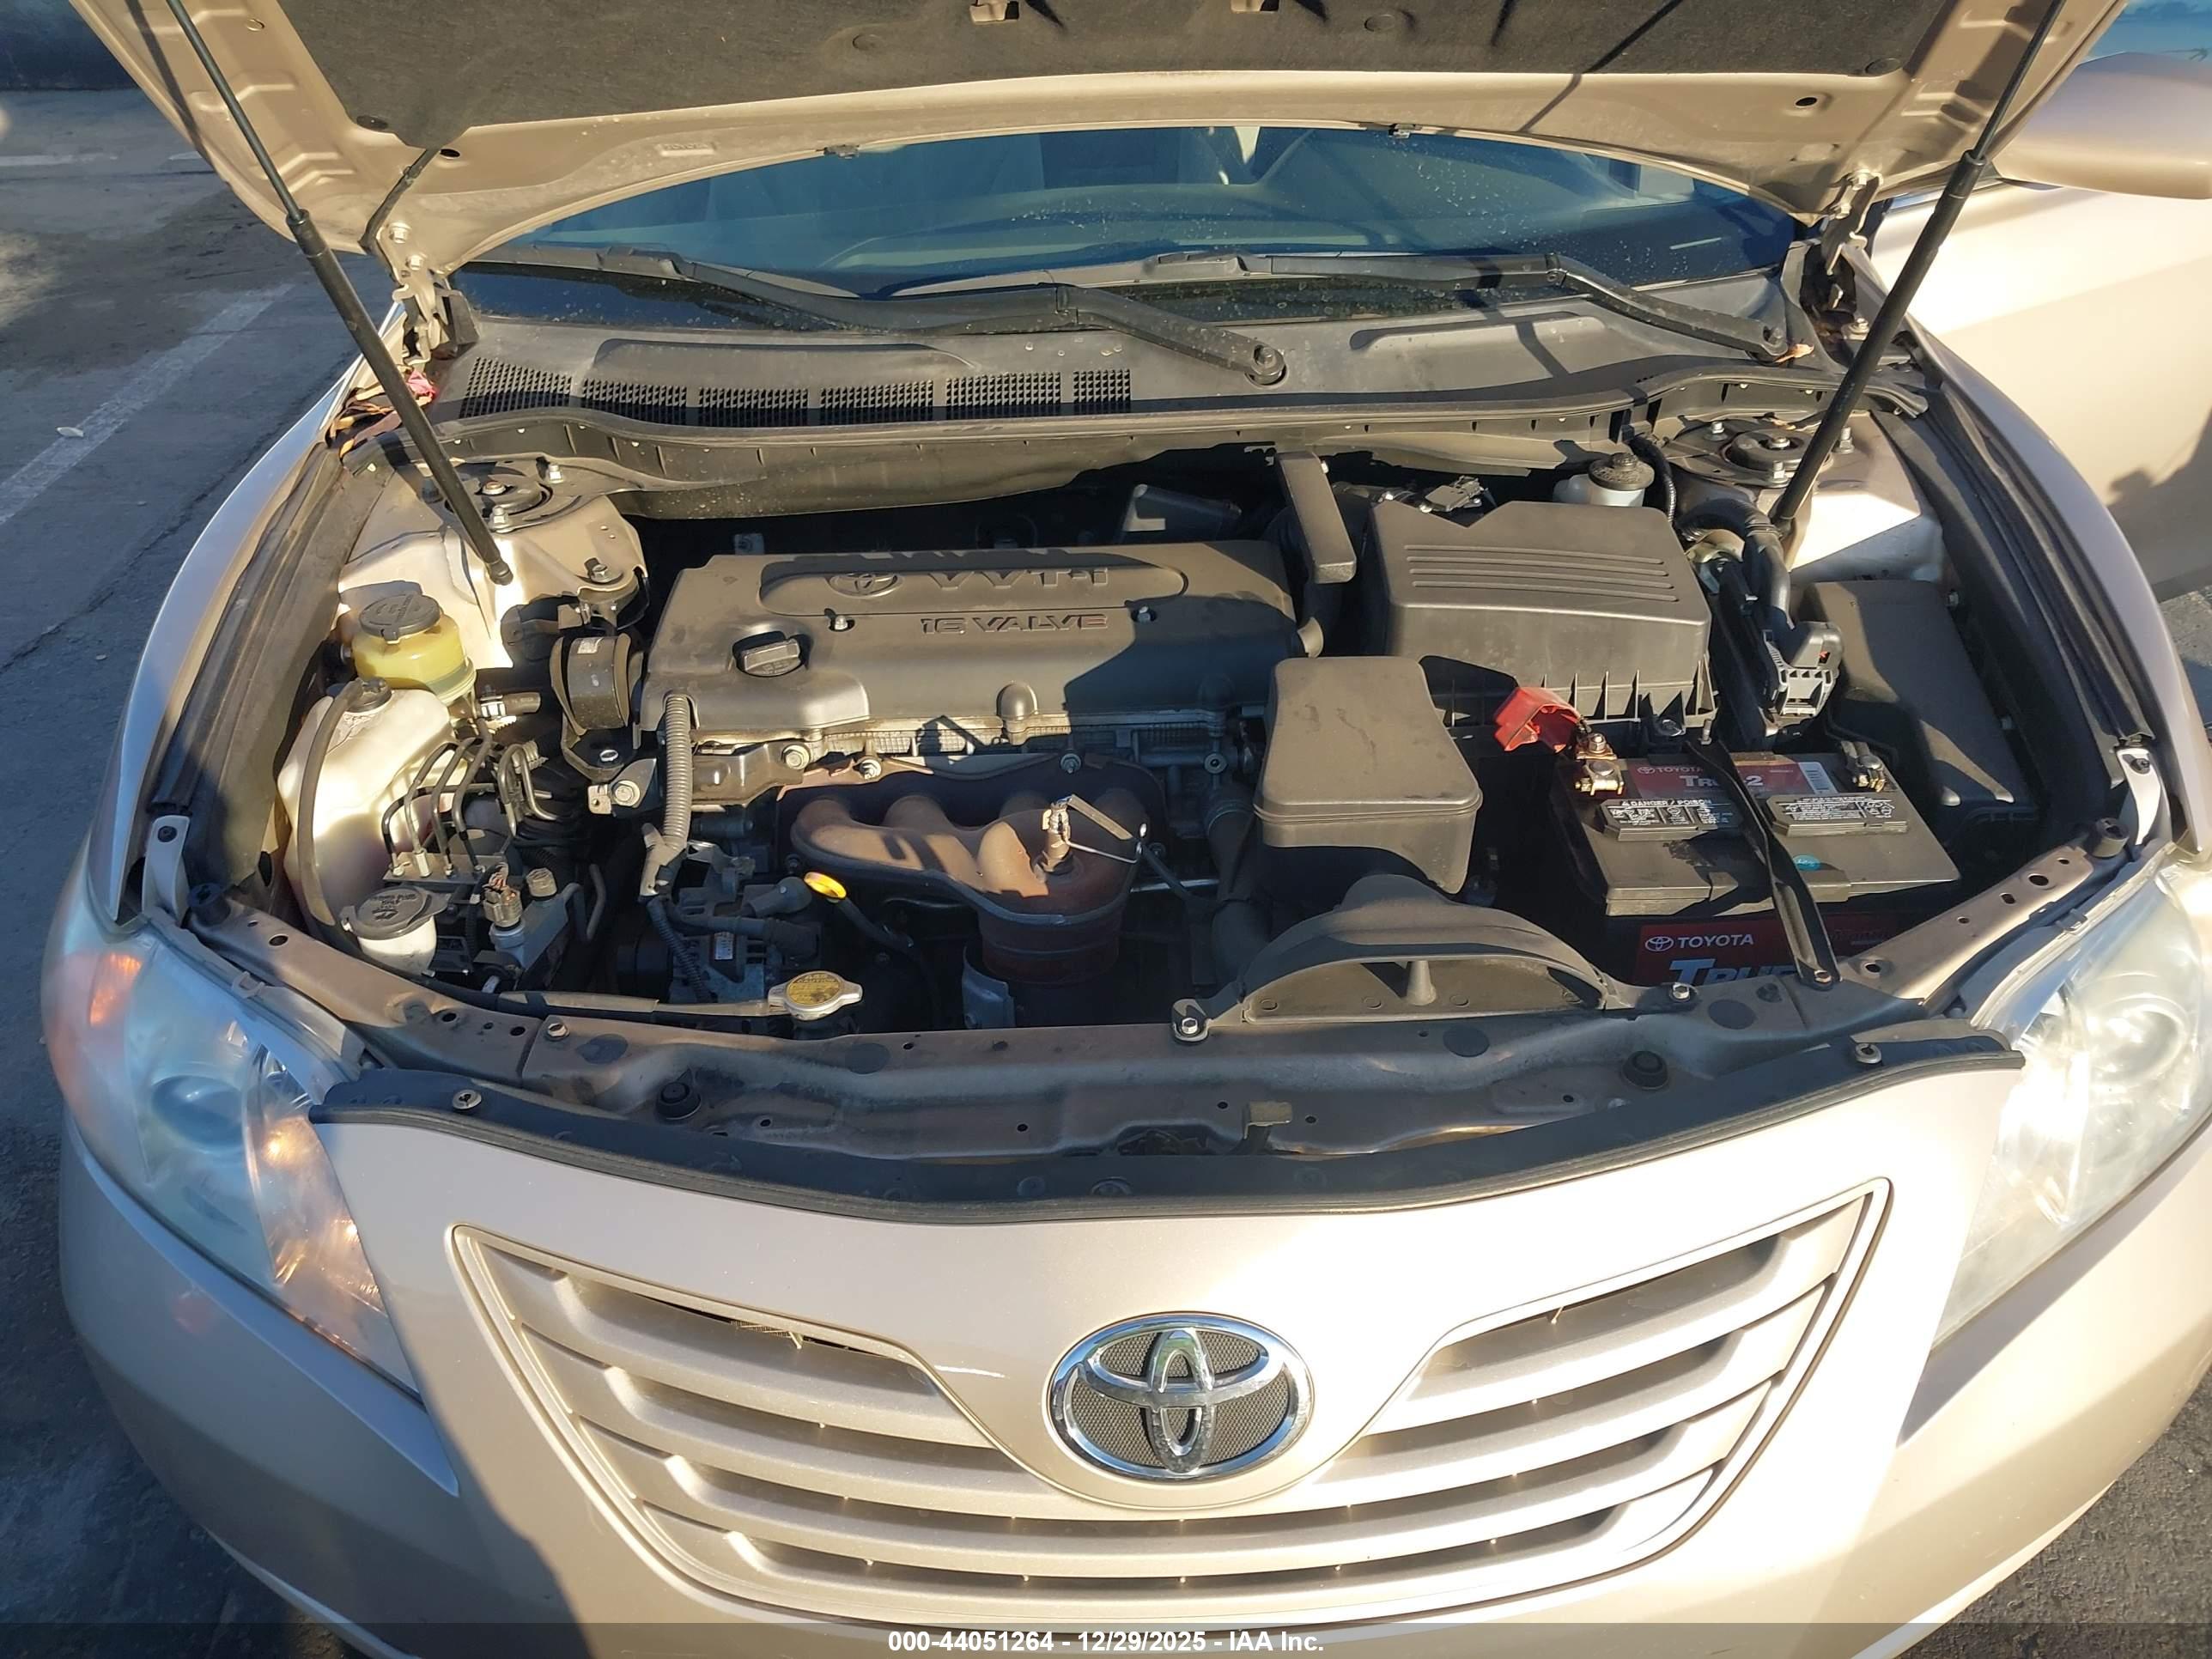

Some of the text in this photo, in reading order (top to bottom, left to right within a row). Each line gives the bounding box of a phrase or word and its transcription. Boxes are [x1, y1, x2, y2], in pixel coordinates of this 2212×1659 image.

[920, 613, 1109, 635] 16 VALVE
[1677, 933, 1754, 949] TOYOTA
